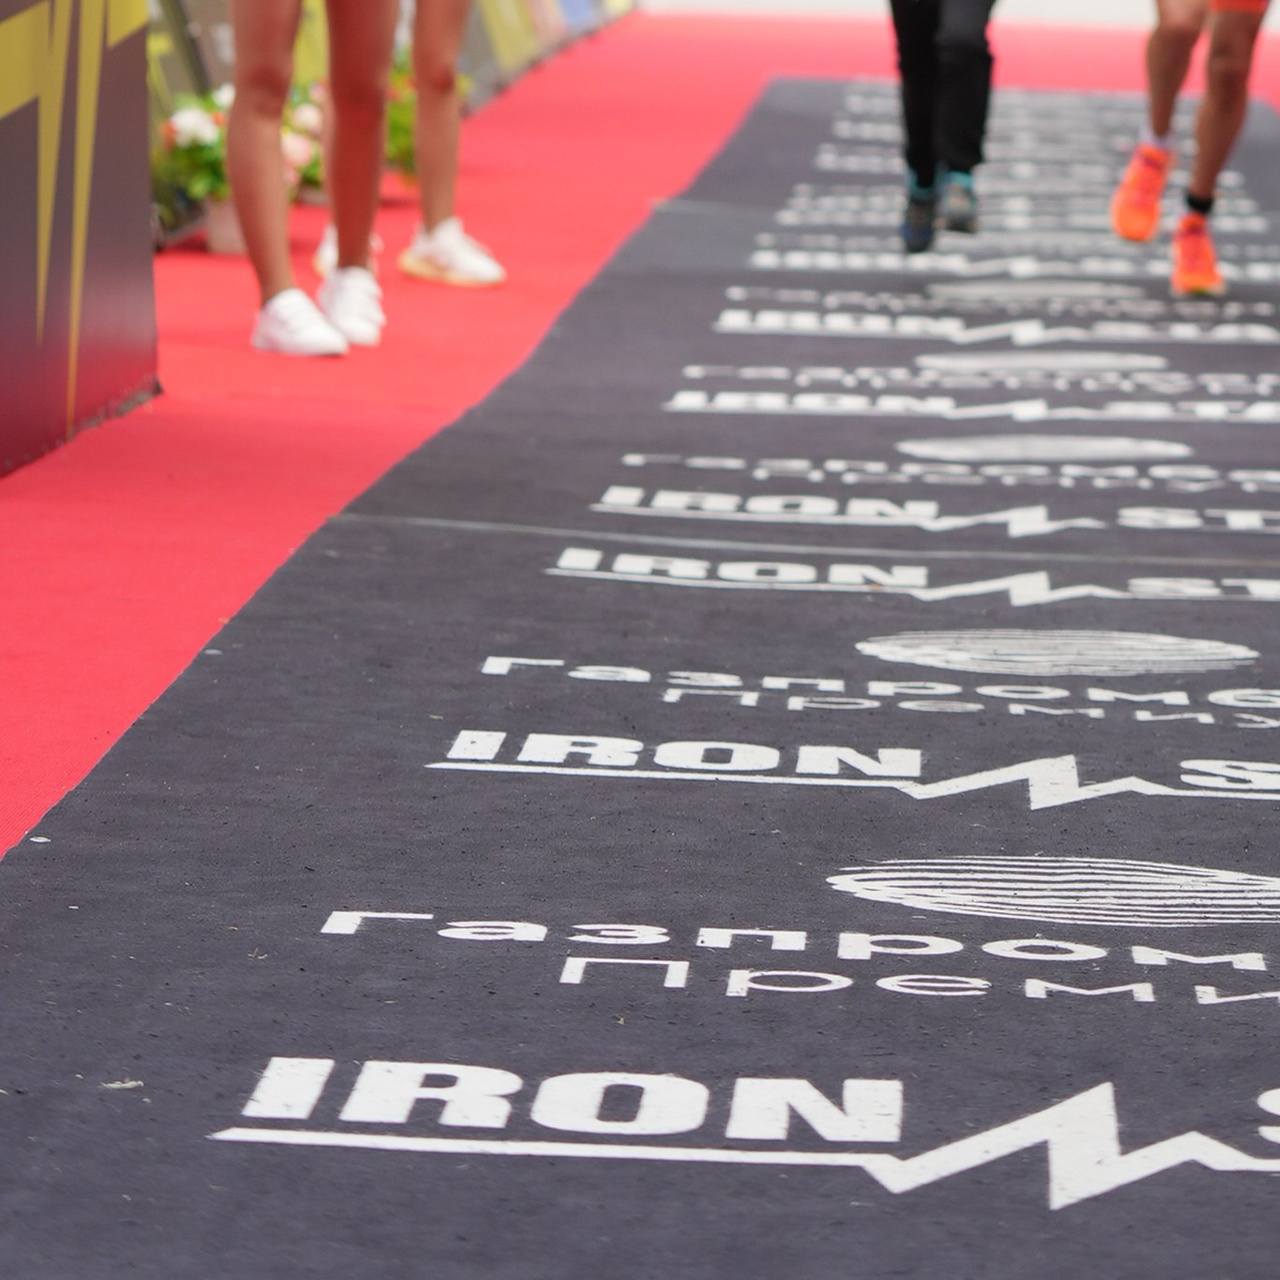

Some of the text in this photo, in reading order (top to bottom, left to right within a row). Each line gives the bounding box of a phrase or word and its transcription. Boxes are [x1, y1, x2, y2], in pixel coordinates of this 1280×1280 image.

[600, 485, 939, 519] IRON
[556, 547, 929, 587] IRON
[445, 729, 923, 777] IRON
[240, 1056, 904, 1143] IRON
